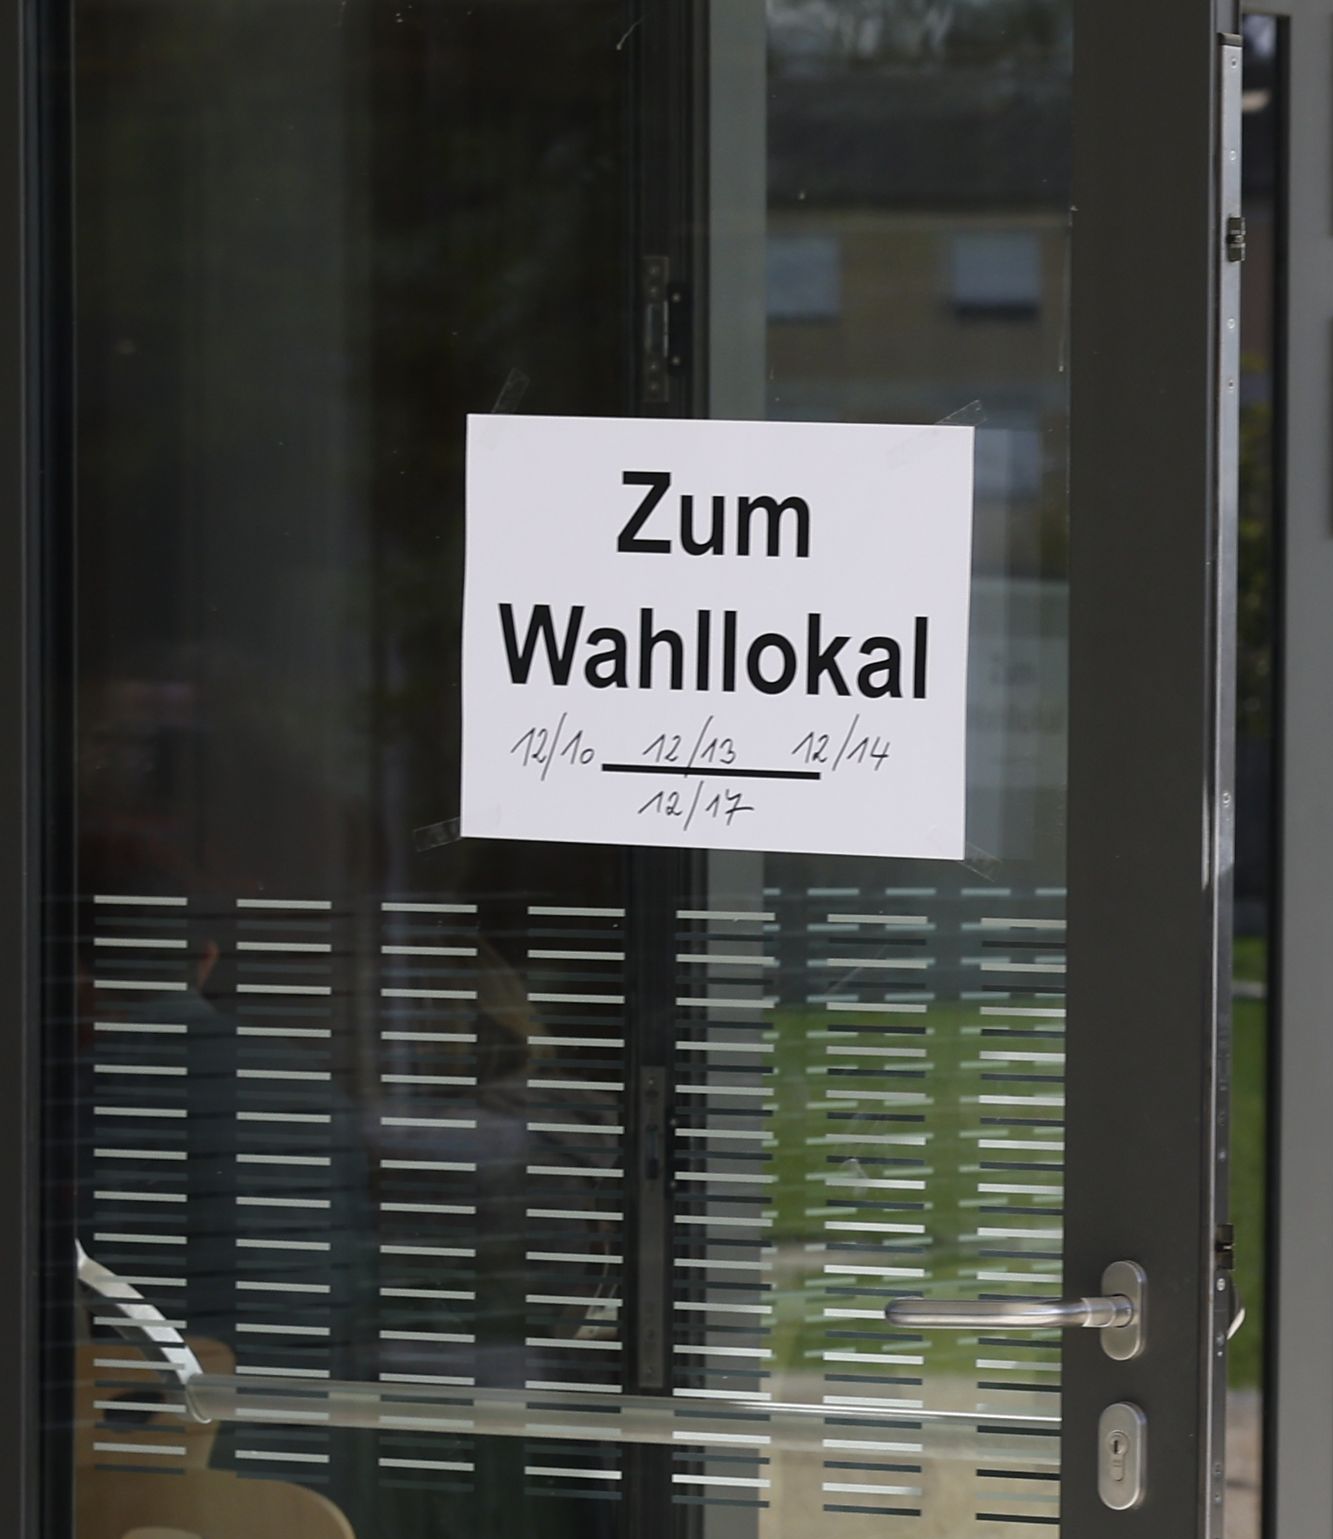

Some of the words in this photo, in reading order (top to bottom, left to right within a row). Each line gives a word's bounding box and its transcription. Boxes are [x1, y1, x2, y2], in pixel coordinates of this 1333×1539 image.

[616, 470, 811, 558] Zum
[498, 602, 929, 700] Wahllokal
[510, 711, 595, 782] 12/10
[642, 714, 737, 779] 12/13
[791, 713, 891, 772] 12/14
[637, 780, 755, 832] 12/17
